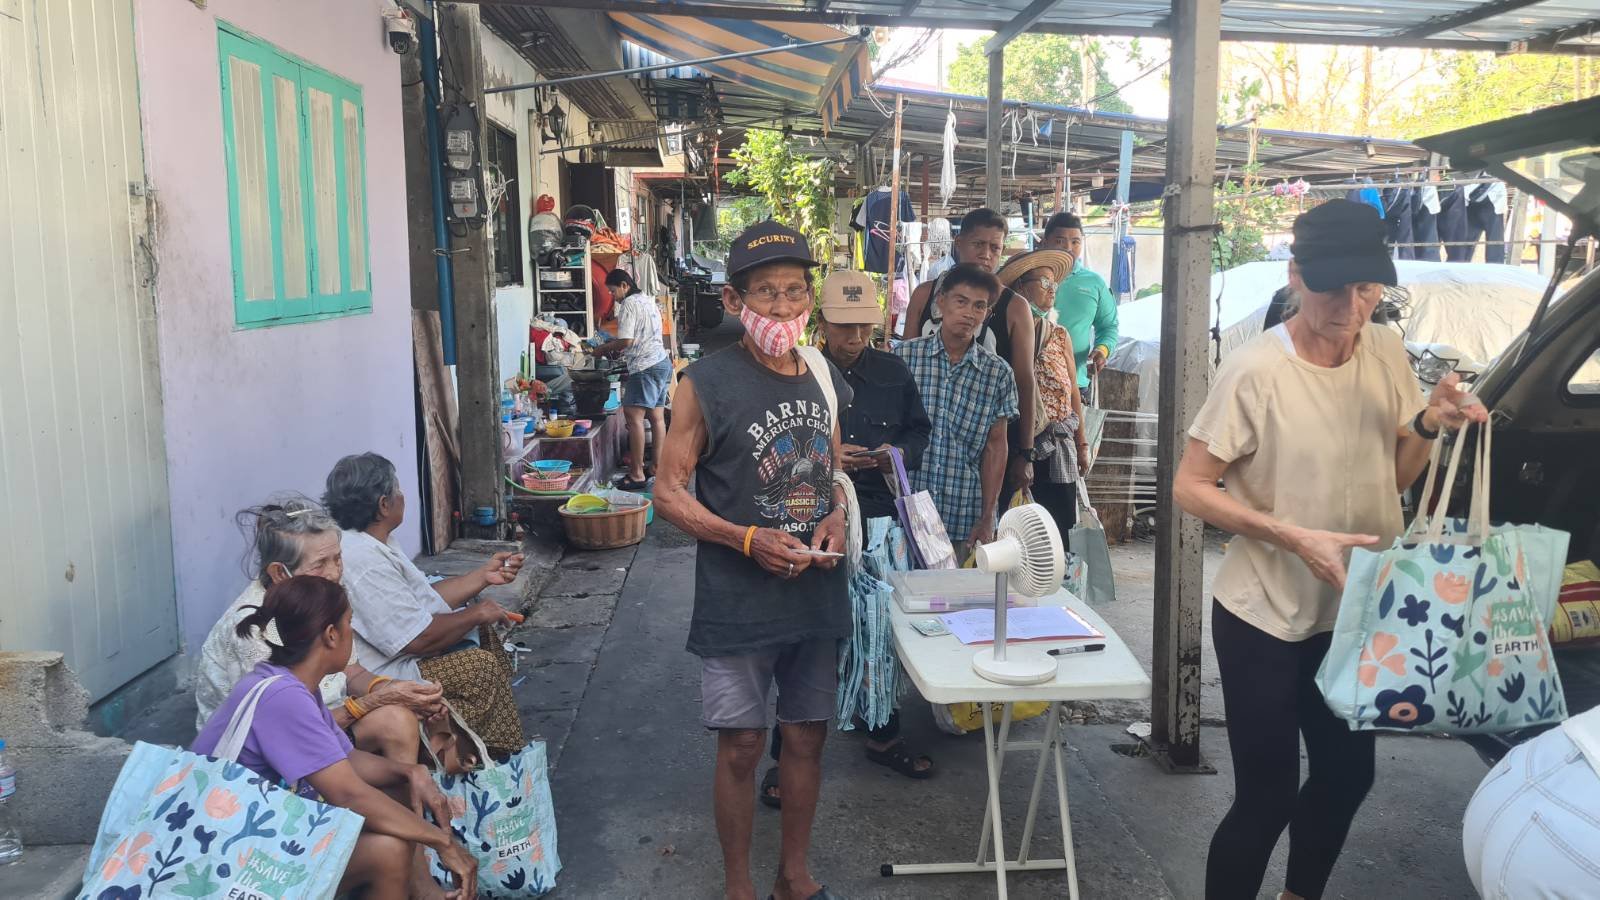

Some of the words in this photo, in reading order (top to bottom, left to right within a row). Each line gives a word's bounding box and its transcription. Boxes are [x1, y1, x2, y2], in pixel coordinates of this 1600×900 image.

[746, 234, 796, 250] SECURITY
[752, 417, 803, 461] AMERICAN
[780, 522, 809, 533] ASO,
[1494, 640, 1539, 655] EARTH
[498, 839, 531, 858] EARTH
[247, 856, 290, 884] #SAVE
[239, 870, 262, 890] the
